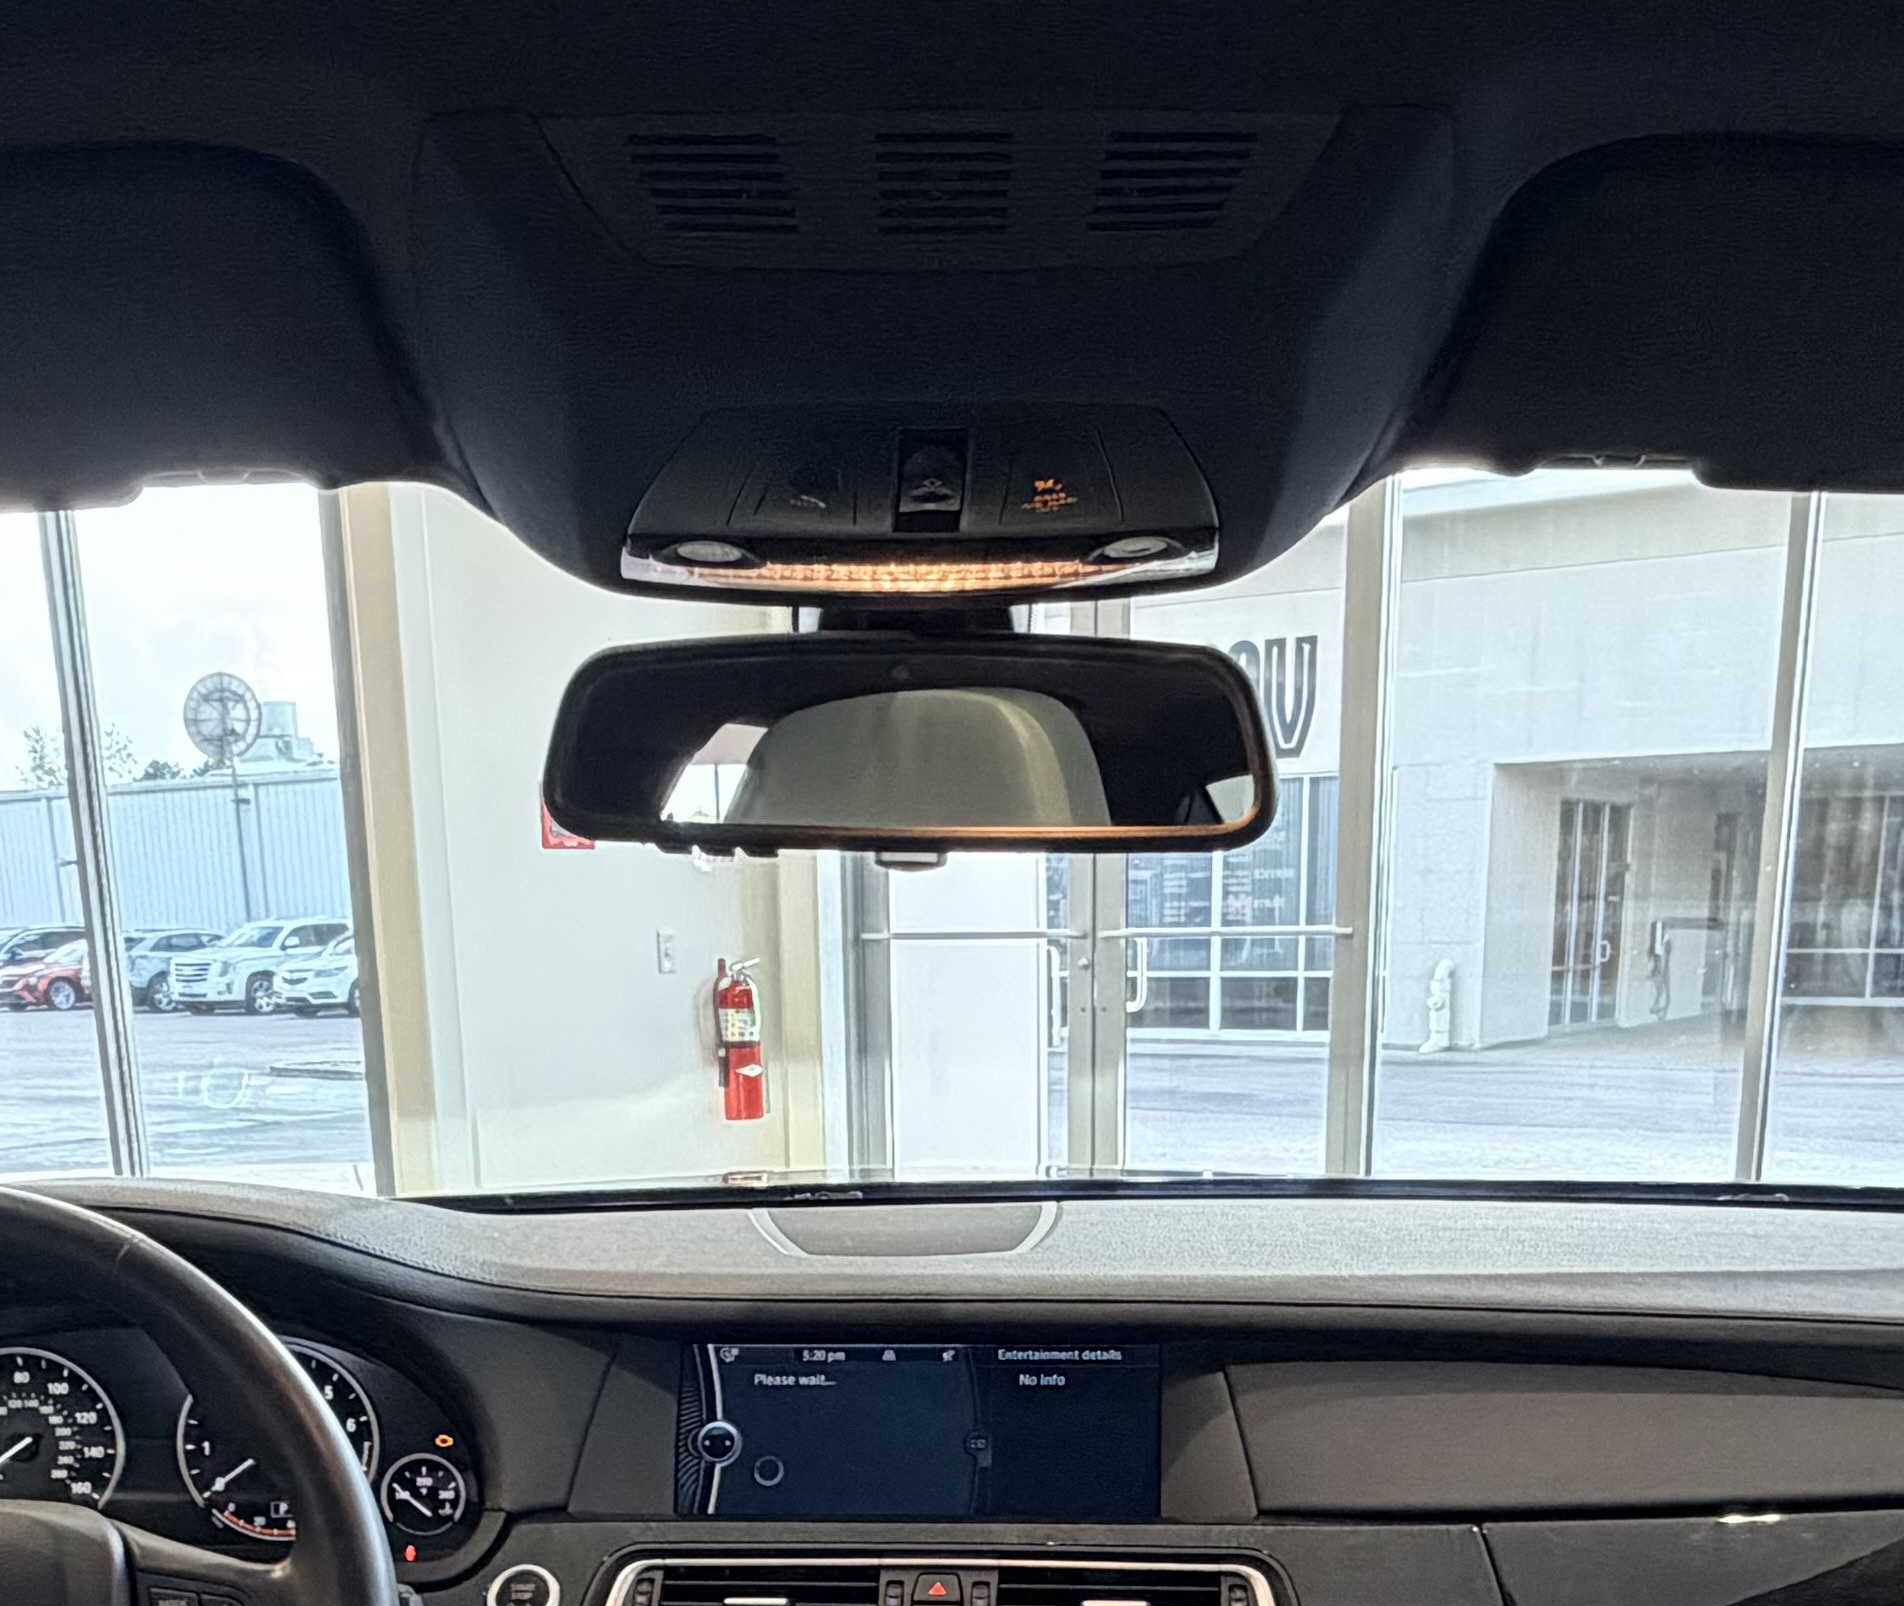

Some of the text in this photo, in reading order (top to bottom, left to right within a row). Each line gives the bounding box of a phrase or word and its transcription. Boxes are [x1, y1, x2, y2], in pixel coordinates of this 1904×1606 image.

[827, 1351, 846, 1363] pm
[997, 1349, 1122, 1361] Entertainment details
[13, 1371, 30, 1384] 80
[754, 1374, 796, 1386] Please
[1019, 1374, 1038, 1386] No
[47, 1382, 69, 1395] 100
[323, 1385, 334, 1400] 5
[75, 1411, 97, 1424] 120
[346, 1418, 356, 1432] 6
[83, 1446, 105, 1458] 140
[201, 1441, 211, 1456] 1
[70, 1481, 92, 1494] 160
